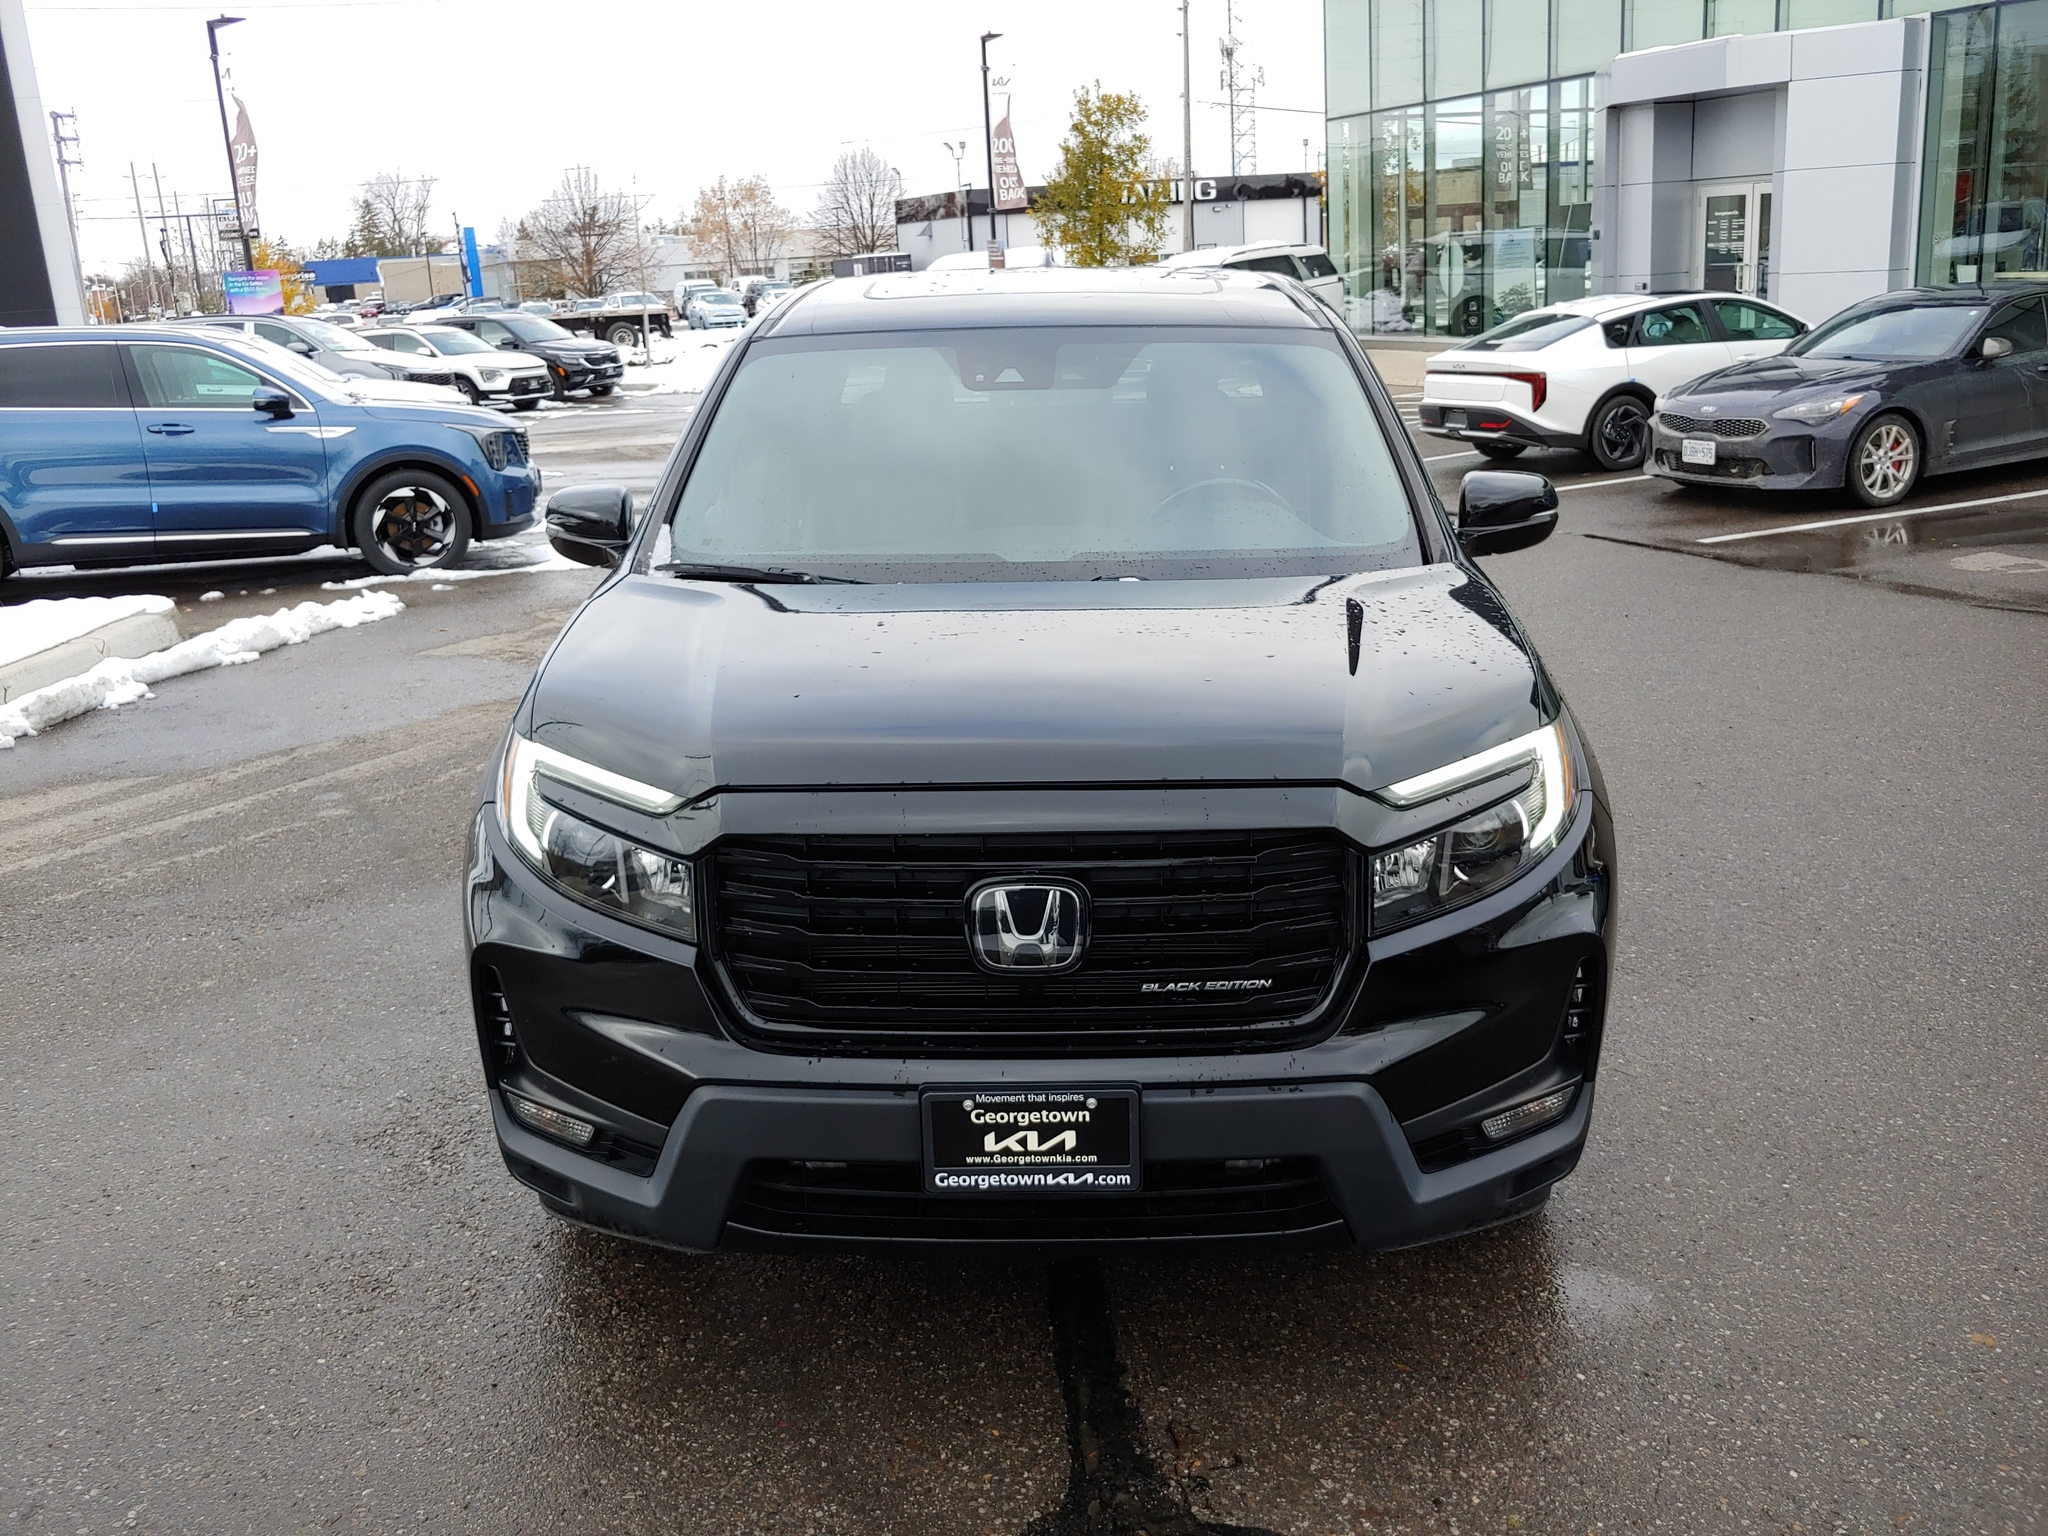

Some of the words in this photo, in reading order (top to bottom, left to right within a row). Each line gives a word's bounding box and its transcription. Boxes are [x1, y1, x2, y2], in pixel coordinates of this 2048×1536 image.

[1140, 981, 1203, 993] BLACK
[1203, 978, 1273, 991] EDITION
[975, 1094, 1026, 1104] Movement
[1027, 1093, 1047, 1103] that
[1048, 1093, 1084, 1104] inspires
[970, 1109, 1091, 1127] Georgetown
[965, 1154, 1098, 1165] www.Georgetownkia.com
